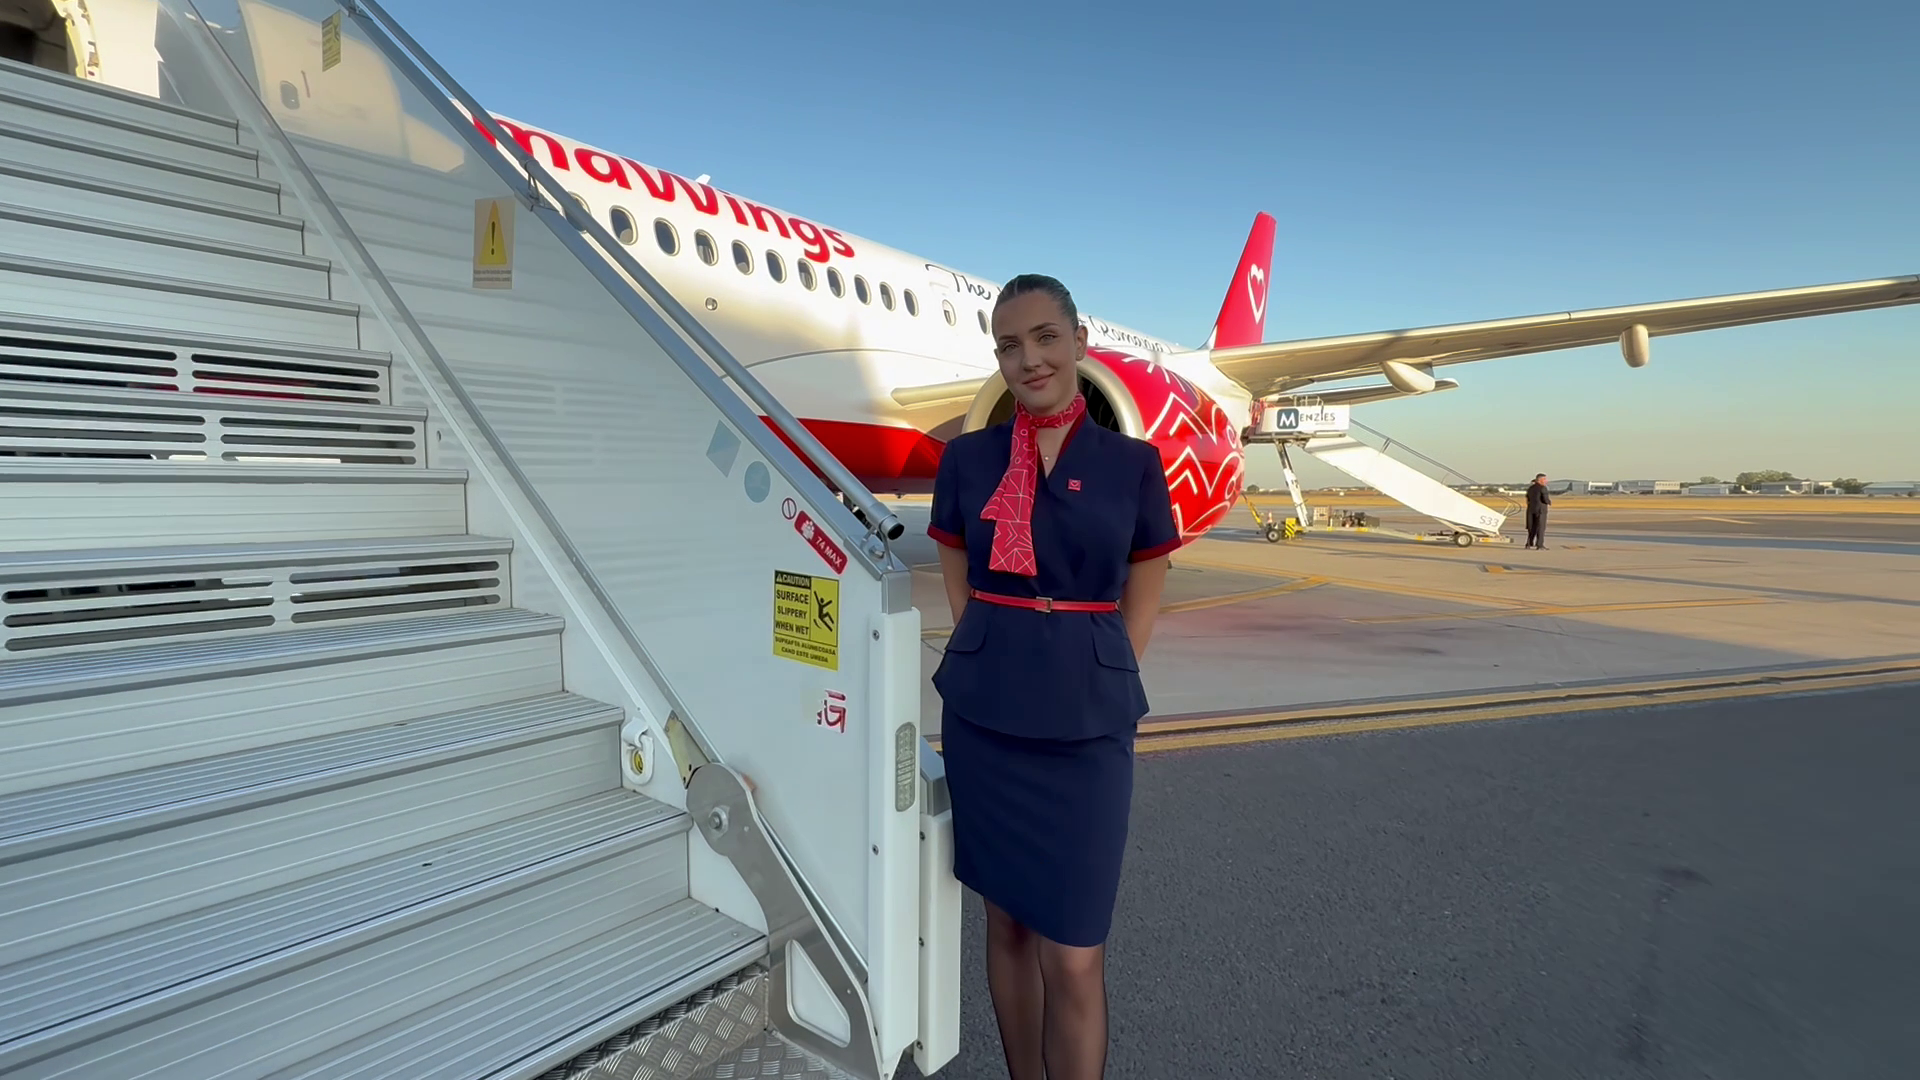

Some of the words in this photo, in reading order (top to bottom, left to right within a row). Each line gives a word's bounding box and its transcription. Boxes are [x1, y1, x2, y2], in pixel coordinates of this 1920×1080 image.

[925, 263, 991, 300] The
[1279, 411, 1336, 427] MENZIES
[1480, 515, 1499, 527] S33
[816, 536, 826, 550] 74
[824, 545, 842, 567] MAX
[782, 574, 810, 587] CAUTION
[776, 589, 809, 605] SURFACE
[777, 605, 807, 620] SLIPPERY
[775, 620, 794, 632] WHEN
[795, 624, 809, 636] WET
[781, 646, 796, 655] CAND
[796, 650, 810, 659] ESTE
